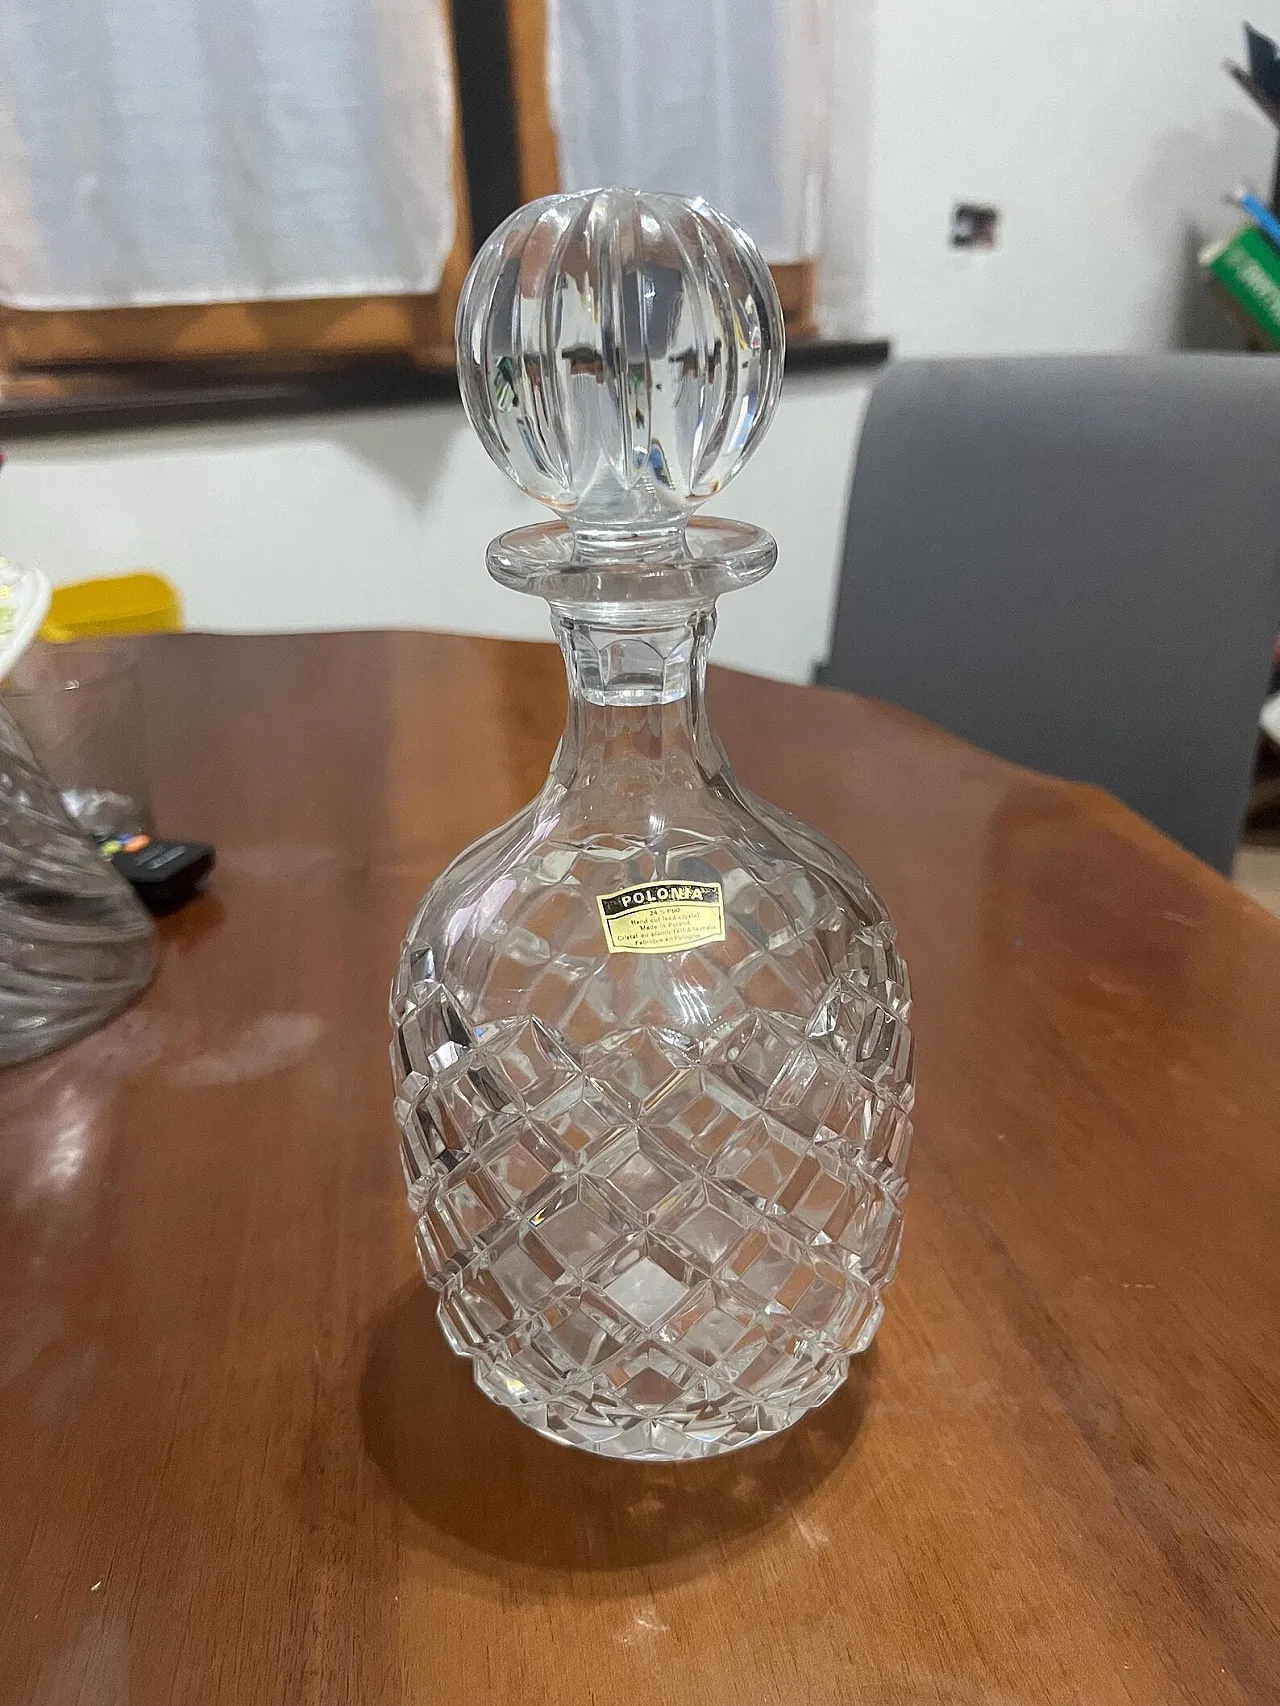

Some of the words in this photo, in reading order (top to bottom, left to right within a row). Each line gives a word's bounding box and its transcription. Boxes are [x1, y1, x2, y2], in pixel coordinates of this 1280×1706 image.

[621, 888, 704, 908] POLONIA
[677, 912, 699, 920] crystal
[668, 920, 690, 928] Poland
[618, 933, 638, 941] Cristal
